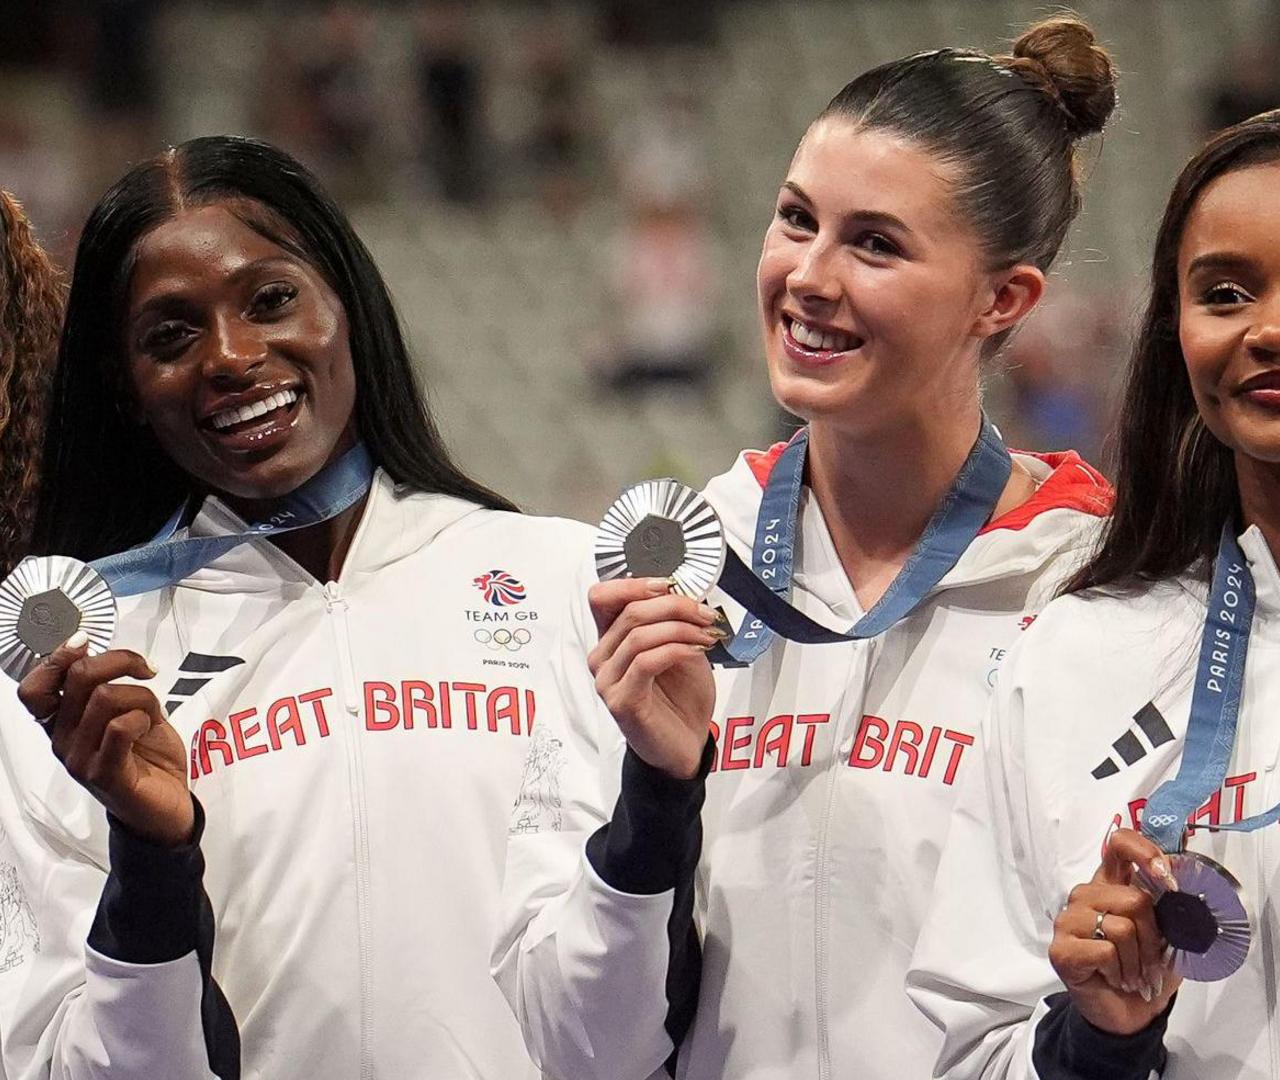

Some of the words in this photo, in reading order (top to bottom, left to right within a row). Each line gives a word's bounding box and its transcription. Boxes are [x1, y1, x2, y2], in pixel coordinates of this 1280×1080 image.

[761, 518, 781, 580] 2024
[464, 610, 509, 622] TEAM
[514, 611, 539, 621] GB
[1219, 562, 1243, 625] 2024
[848, 714, 975, 786] BRIT
